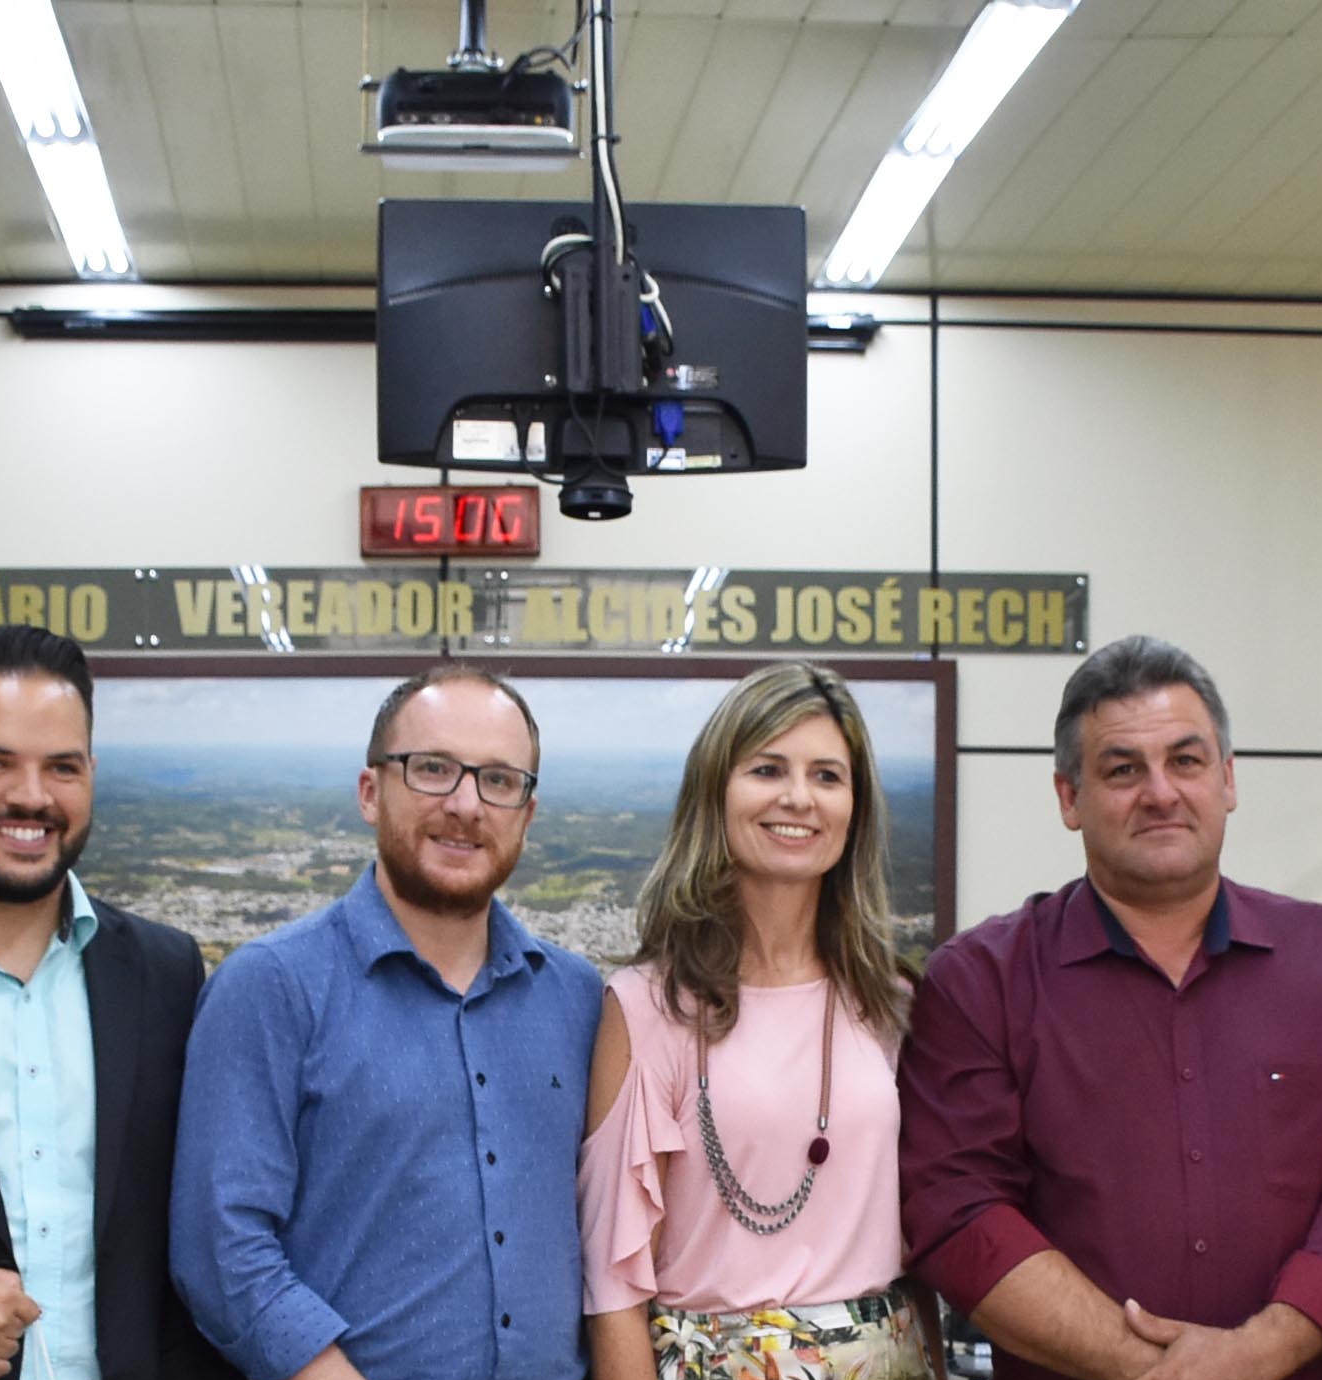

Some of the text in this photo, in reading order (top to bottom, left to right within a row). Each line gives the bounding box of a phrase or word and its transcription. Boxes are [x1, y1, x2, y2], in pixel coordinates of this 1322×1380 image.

[174, 578, 474, 639] VEREADOR
[521, 583, 758, 644] ALCIDES
[771, 577, 903, 645] JOSÉ
[918, 586, 1065, 648] RECH
